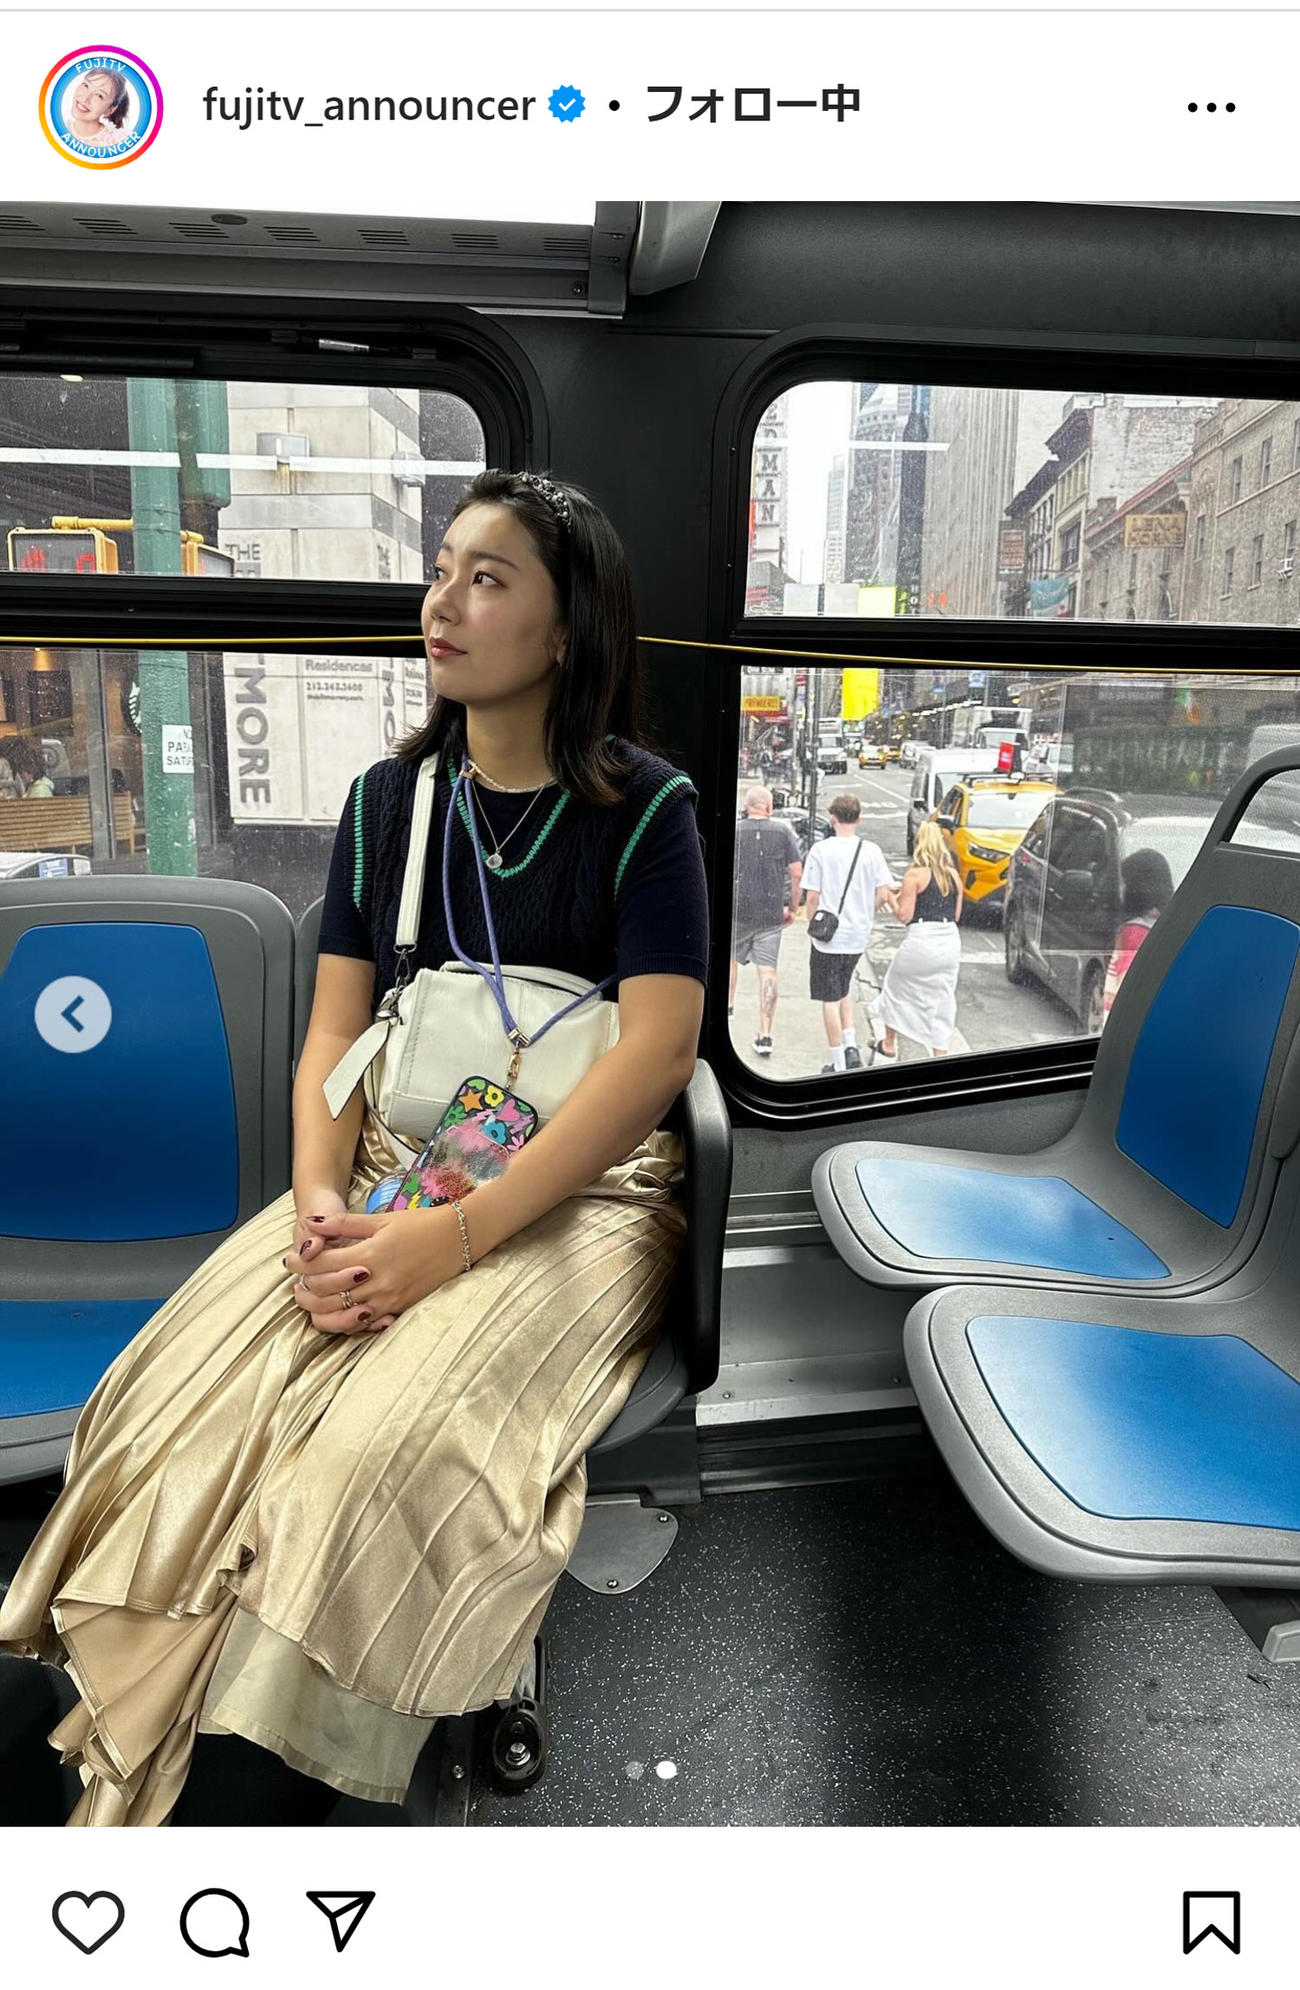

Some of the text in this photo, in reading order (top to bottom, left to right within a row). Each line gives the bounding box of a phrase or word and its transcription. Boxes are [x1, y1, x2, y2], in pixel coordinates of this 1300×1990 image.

[225, 543, 261, 561] THE
[305, 658, 373, 672] Residences
[234, 655, 271, 804] MORE
